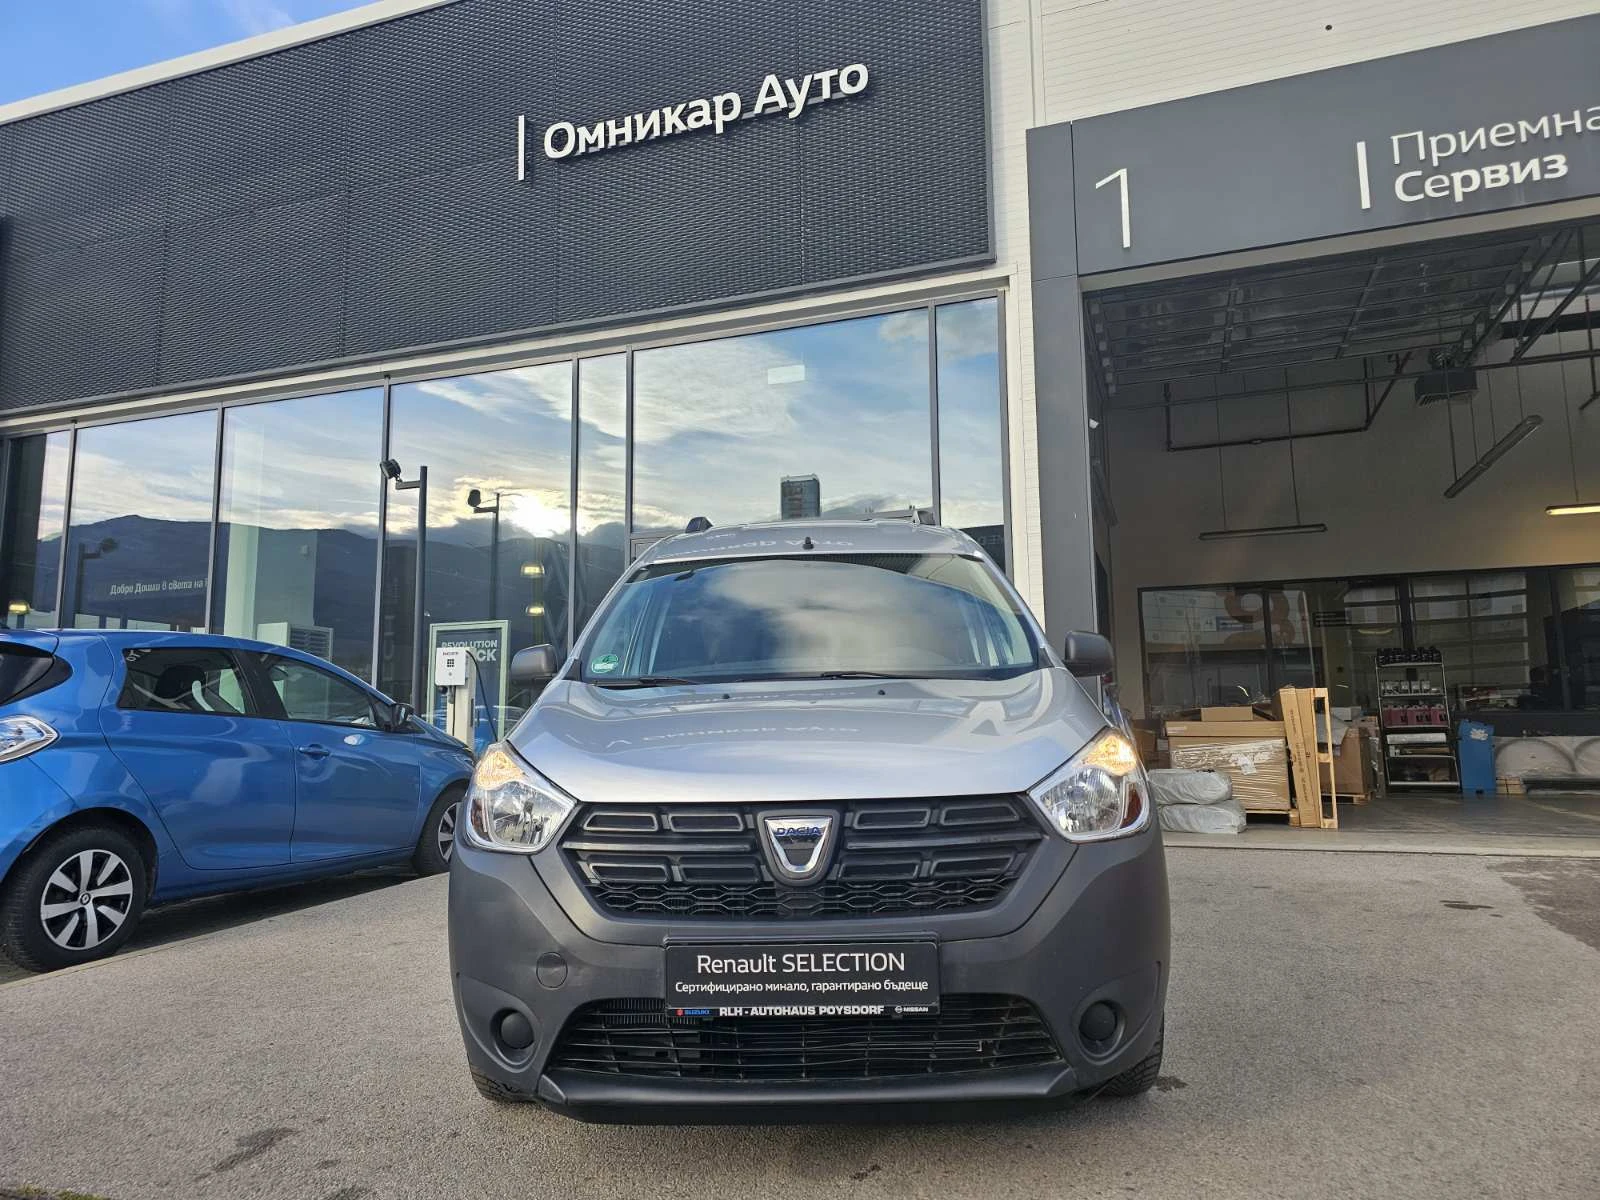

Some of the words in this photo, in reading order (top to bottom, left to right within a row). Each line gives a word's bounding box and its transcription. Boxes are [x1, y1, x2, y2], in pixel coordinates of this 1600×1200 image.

[543, 91, 742, 159] Омникар
[753, 63, 869, 119] Ауто
[1394, 154, 1569, 202] Сервиз
[1095, 167, 1131, 249] 1
[441, 640, 498, 649] REVOLUTION
[775, 826, 821, 836] DACIA
[696, 953, 777, 974] Renault
[781, 952, 906, 973] SELECTION
[675, 981, 763, 995] Сертифицирано
[765, 982, 810, 993] минало,
[811, 981, 882, 993] гарантирано
[883, 979, 929, 991] бъдеще
[719, 1006, 743, 1016] RLH
[750, 1006, 816, 1016] AUTOHAUS
[819, 1005, 885, 1015] POYSDORF
